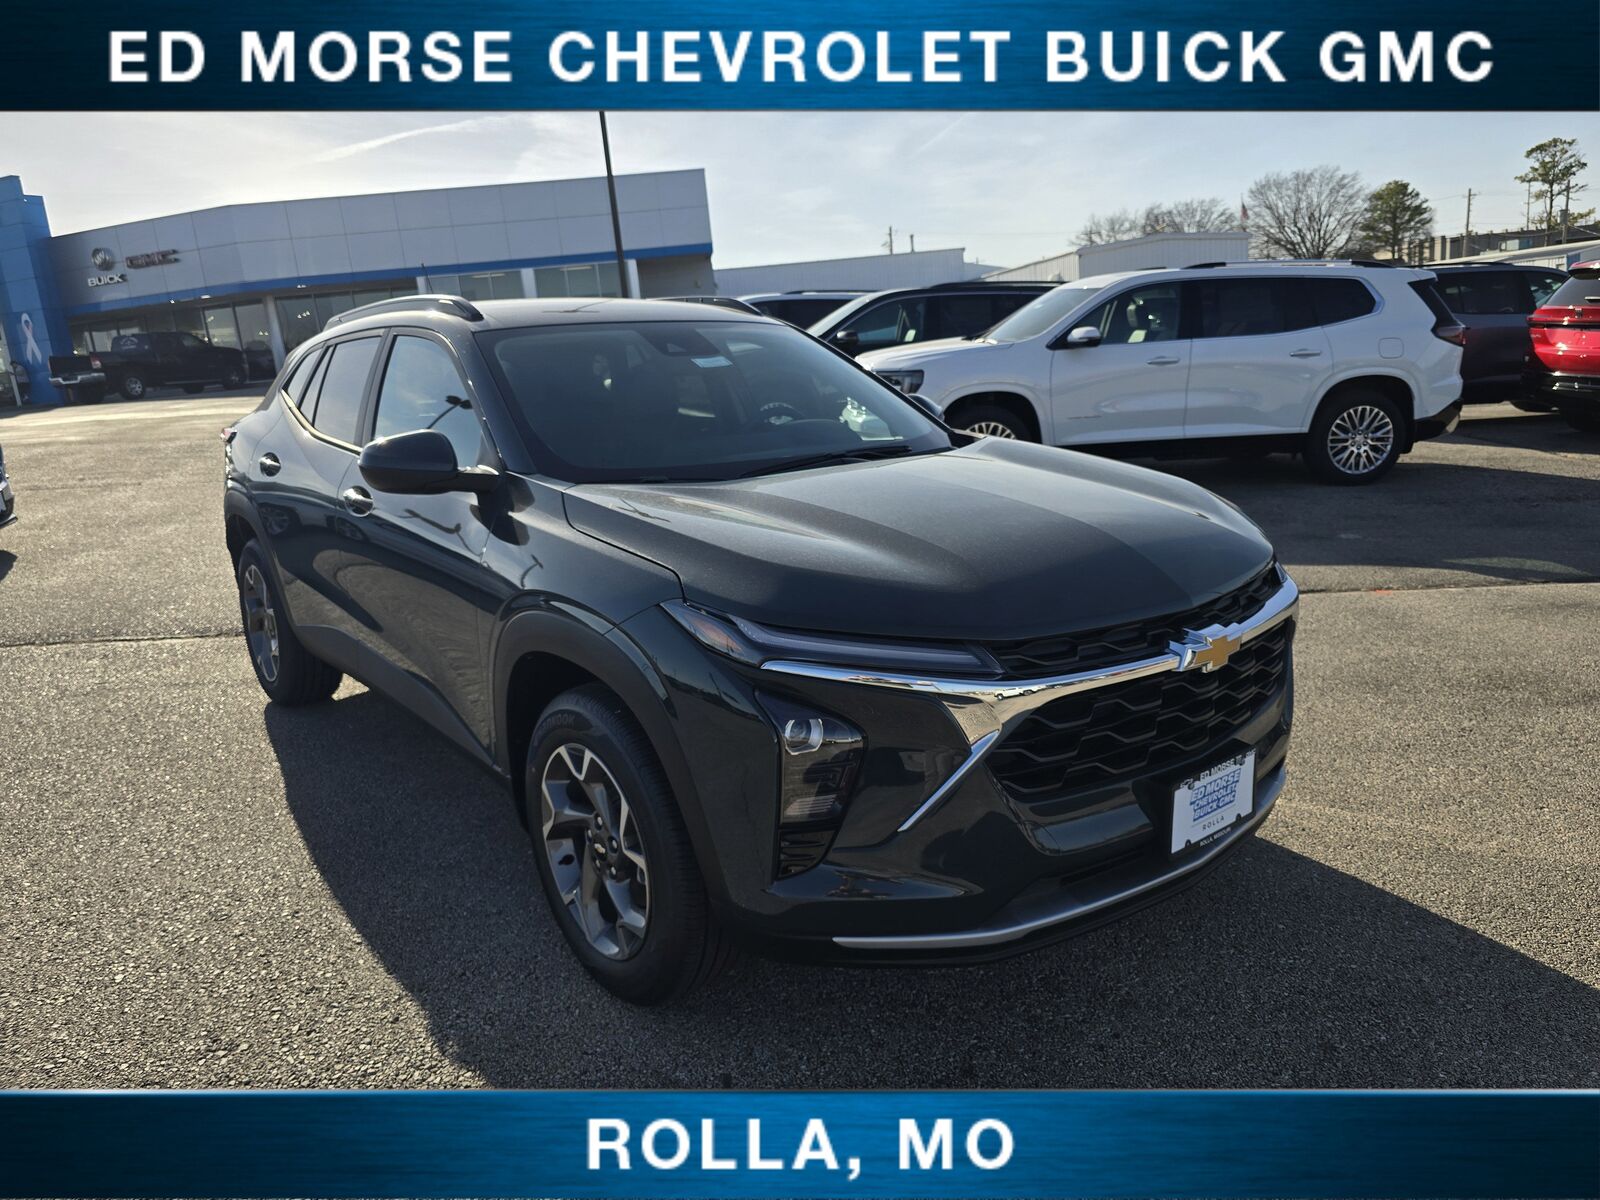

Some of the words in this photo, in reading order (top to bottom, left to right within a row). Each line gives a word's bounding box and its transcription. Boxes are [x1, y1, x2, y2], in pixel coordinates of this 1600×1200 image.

[88, 273, 122, 287] BUICK
[1192, 784, 1206, 800] ED
[1206, 768, 1241, 795] MORSE
[1194, 783, 1237, 809] CHEVROLET
[1202, 815, 1224, 831] ROLLA
